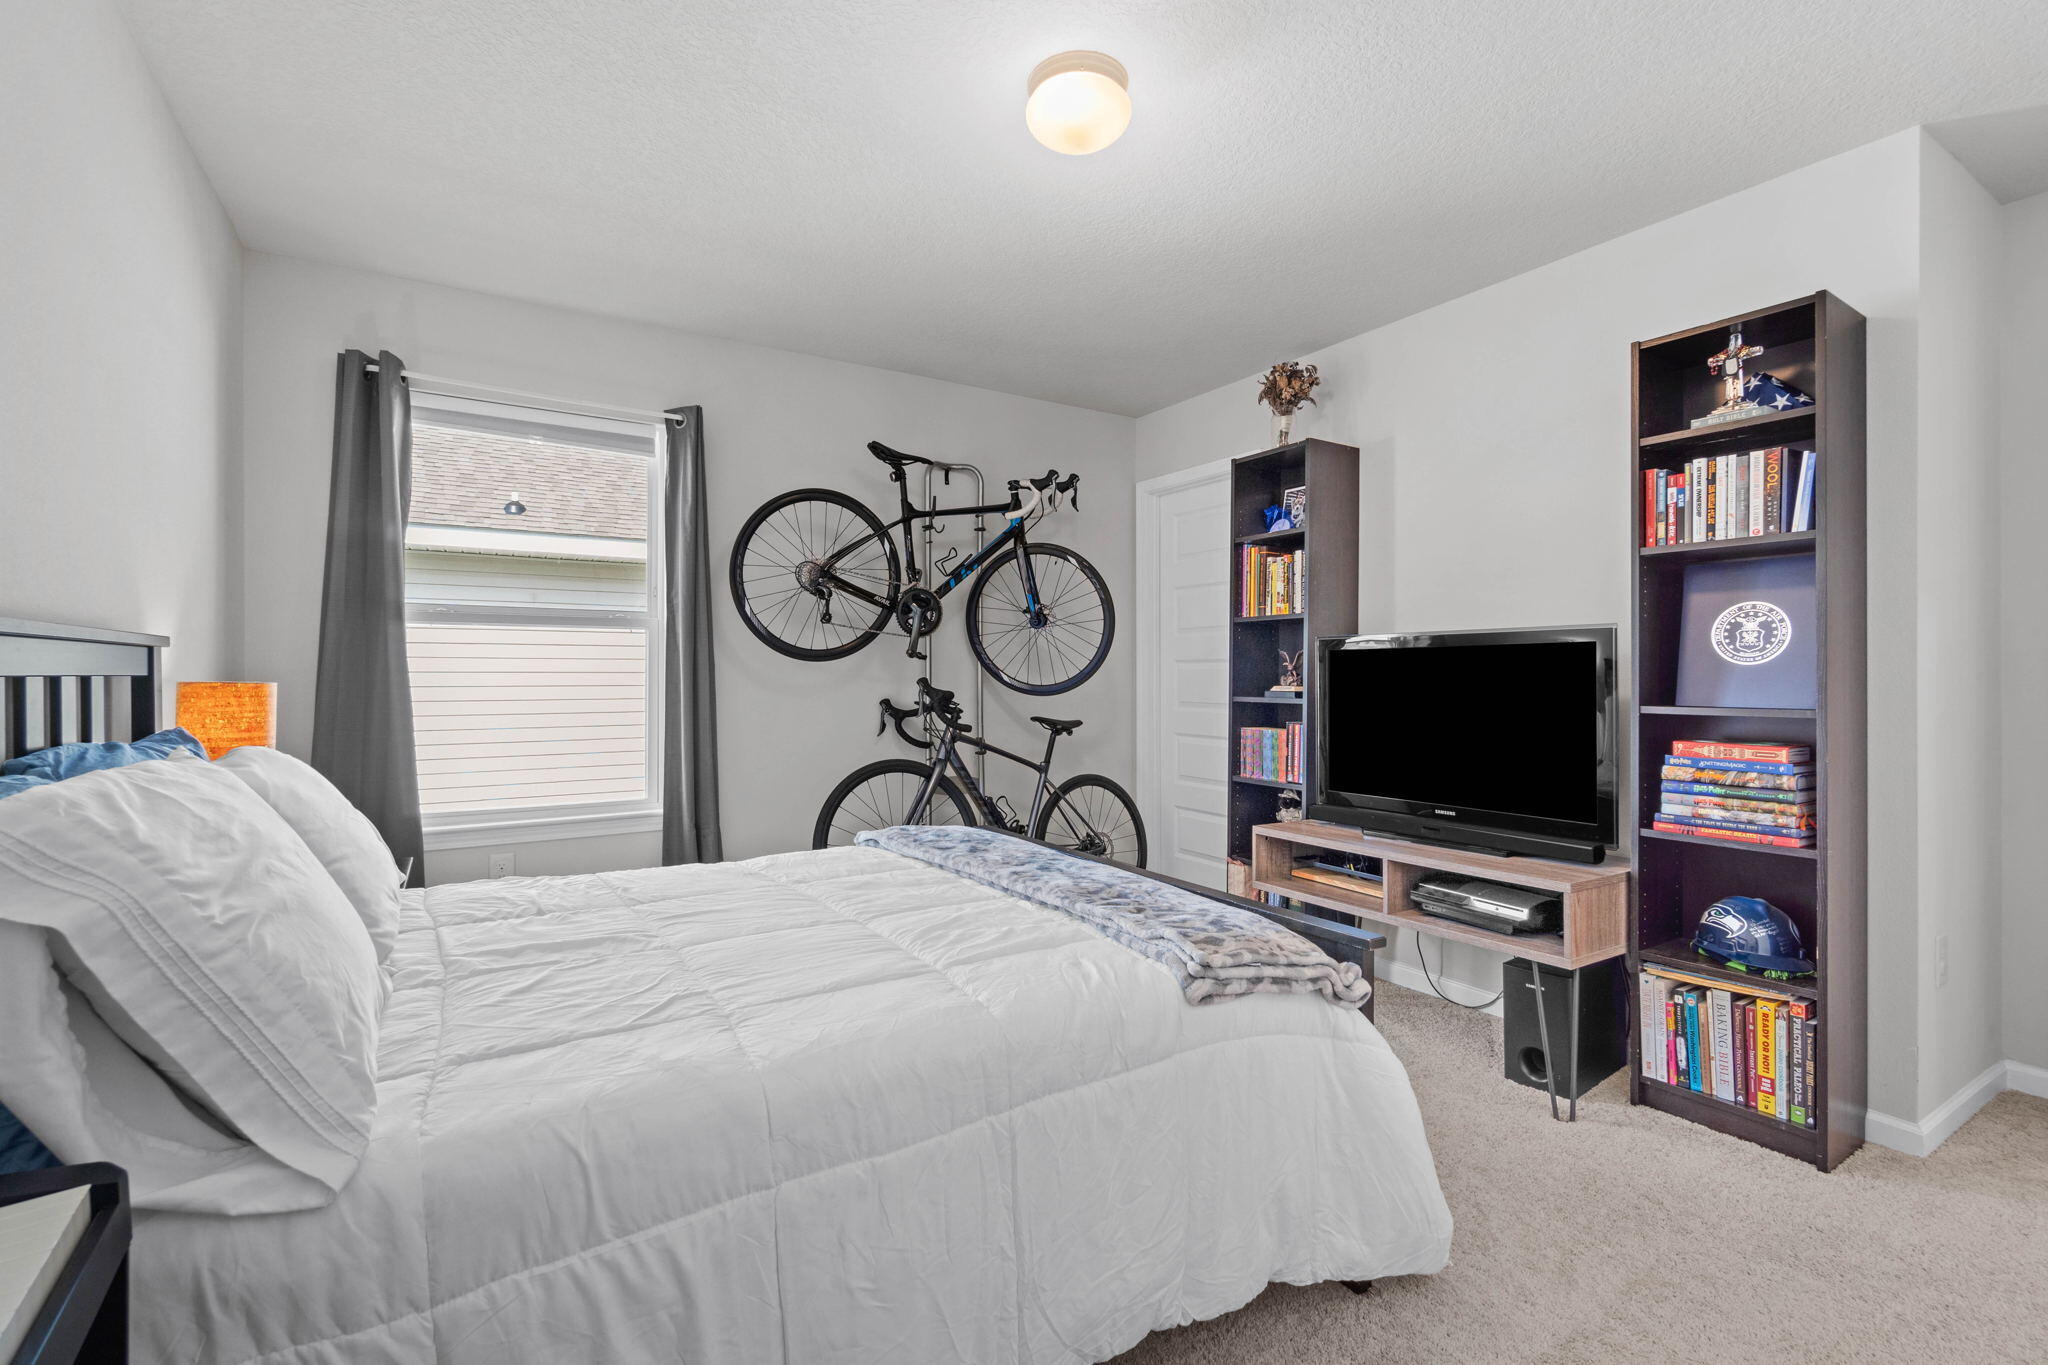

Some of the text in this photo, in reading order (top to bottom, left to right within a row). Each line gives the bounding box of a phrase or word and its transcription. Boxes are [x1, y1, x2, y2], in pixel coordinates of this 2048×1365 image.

[873, 596, 891, 606] AVAIL
[1714, 607, 1740, 640] DEPARTMENT
[1770, 610, 1783, 620] AIR
[1701, 828, 1733, 836] FANTASTIC
[1761, 1013, 1770, 1040] READY
[1688, 1030, 1697, 1065] Washington
[1716, 1003, 1730, 1086] BAKING BIBLE
[1762, 1040, 1770, 1054] OR
[1793, 1017, 1802, 1064] PRACTICAL
[1762, 1054, 1770, 1074] NOT!
[1793, 1066, 1802, 1094] PALEO
